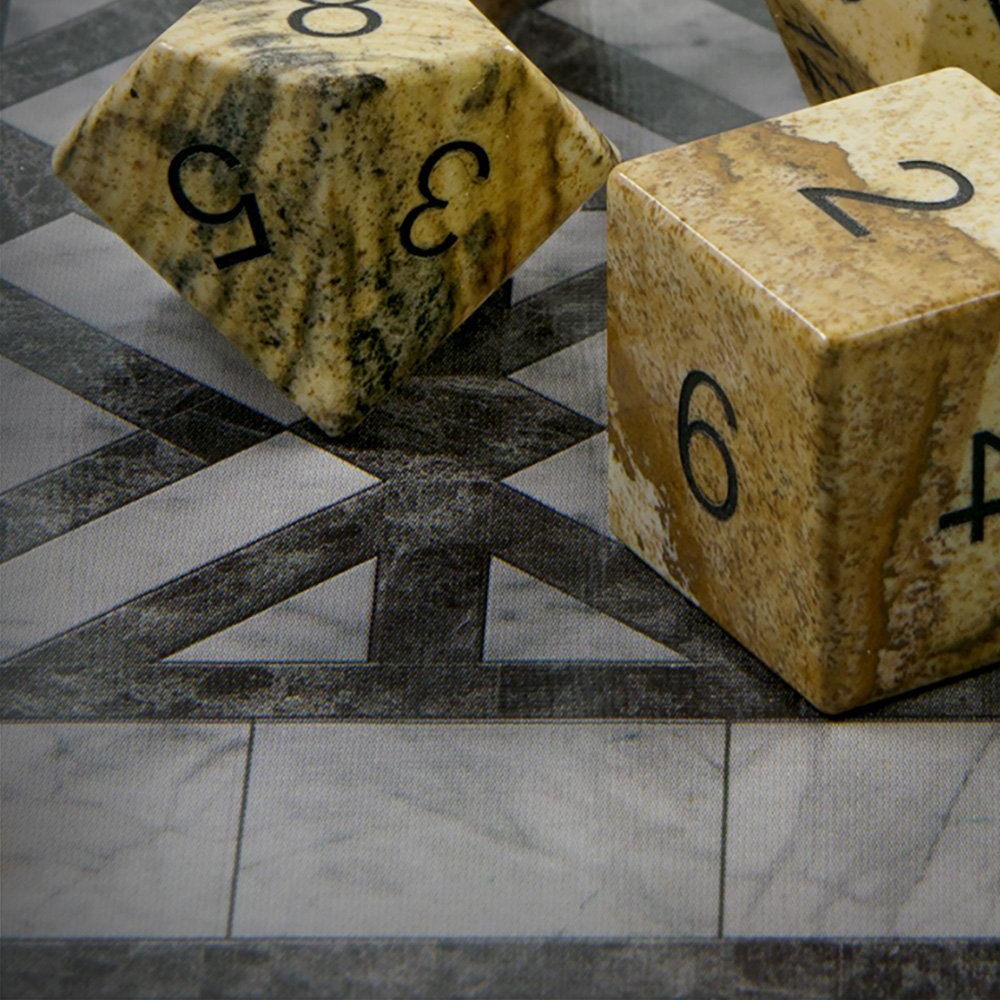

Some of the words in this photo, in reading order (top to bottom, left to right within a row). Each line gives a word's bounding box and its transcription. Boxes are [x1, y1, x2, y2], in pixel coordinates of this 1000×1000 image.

[167, 143, 273, 271] 5
[399, 140, 491, 258] 3
[797, 159, 976, 238] 2
[676, 369, 738, 522] 6
